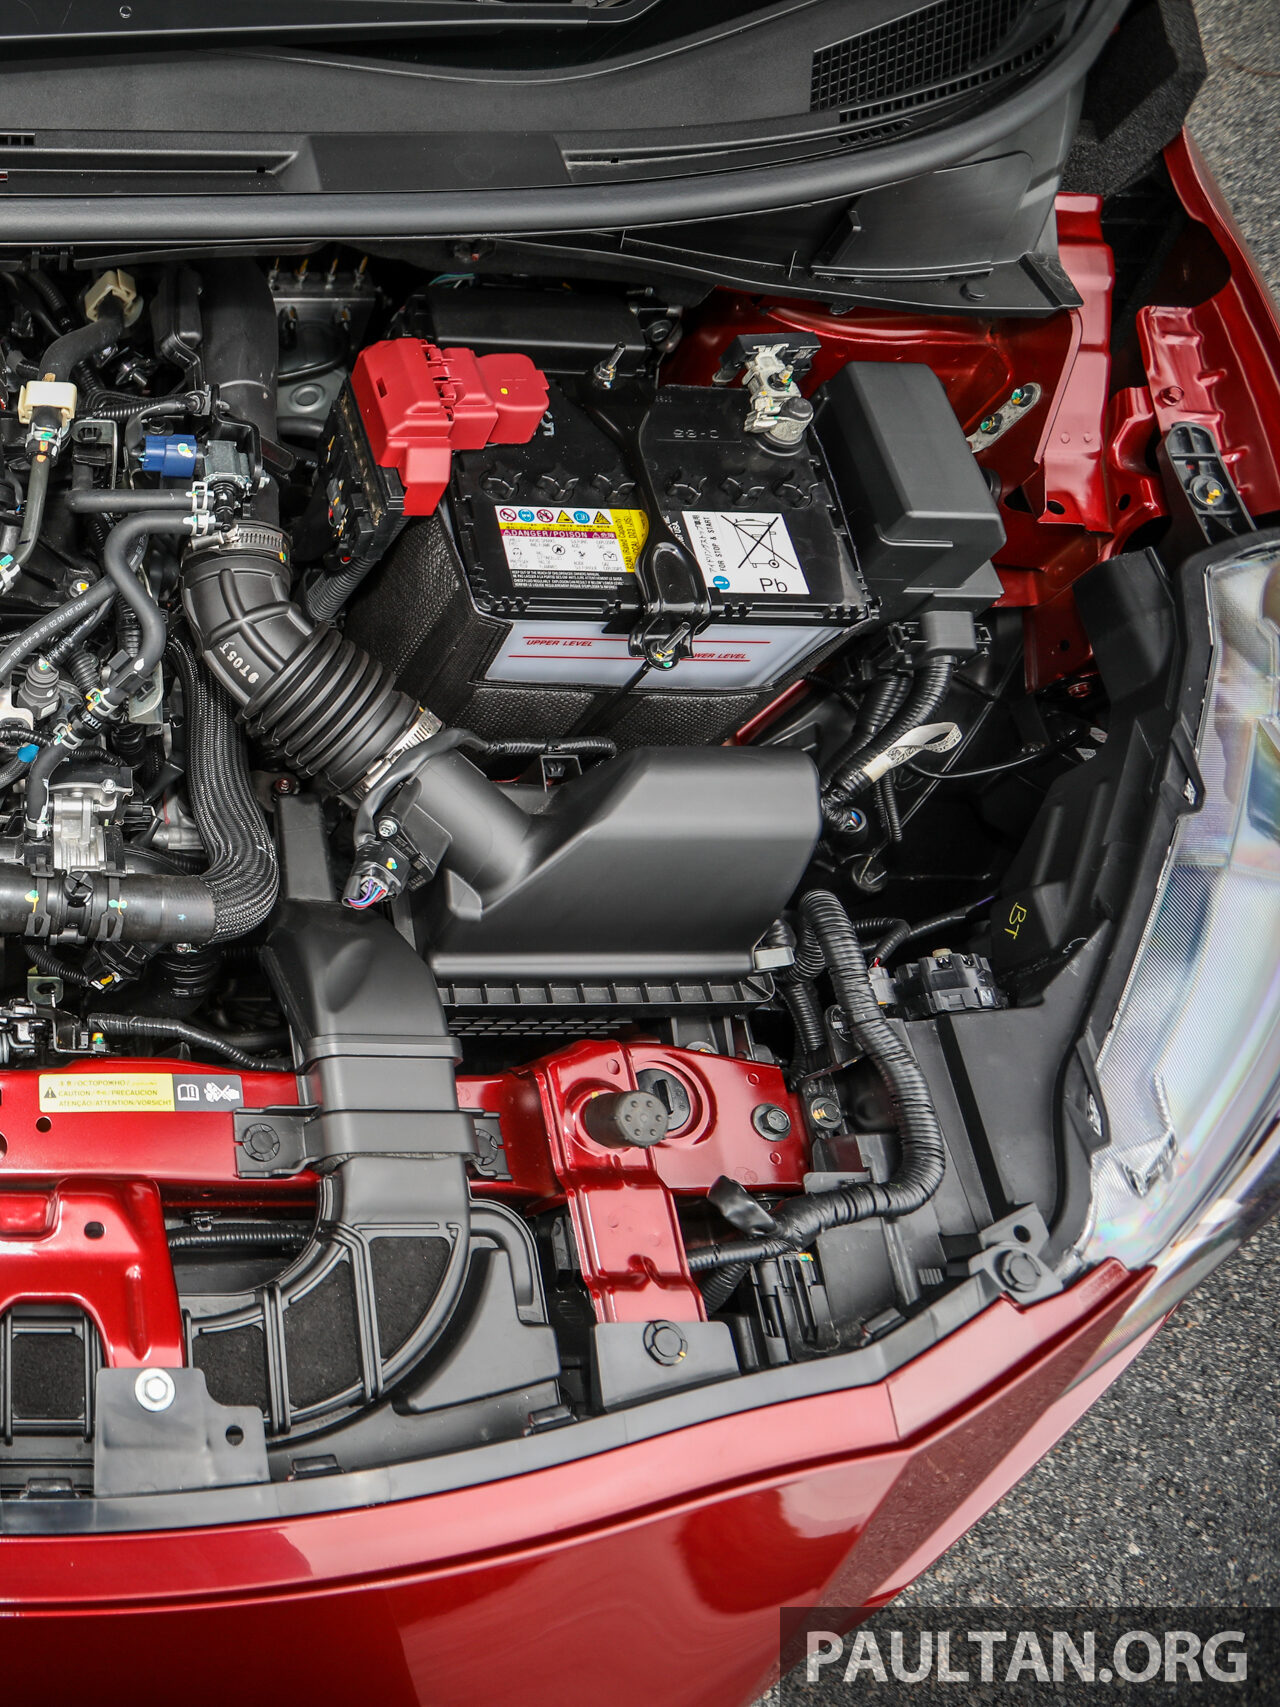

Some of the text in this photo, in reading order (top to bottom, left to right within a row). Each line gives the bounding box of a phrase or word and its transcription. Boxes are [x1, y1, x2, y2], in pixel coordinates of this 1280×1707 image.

[703, 516, 716, 535] START
[713, 543, 723, 560] STOP
[717, 560, 727, 572] FOR
[759, 578, 788, 593] Pb
[526, 639, 559, 647] UPPER
[1004, 902, 1027, 940] BT
